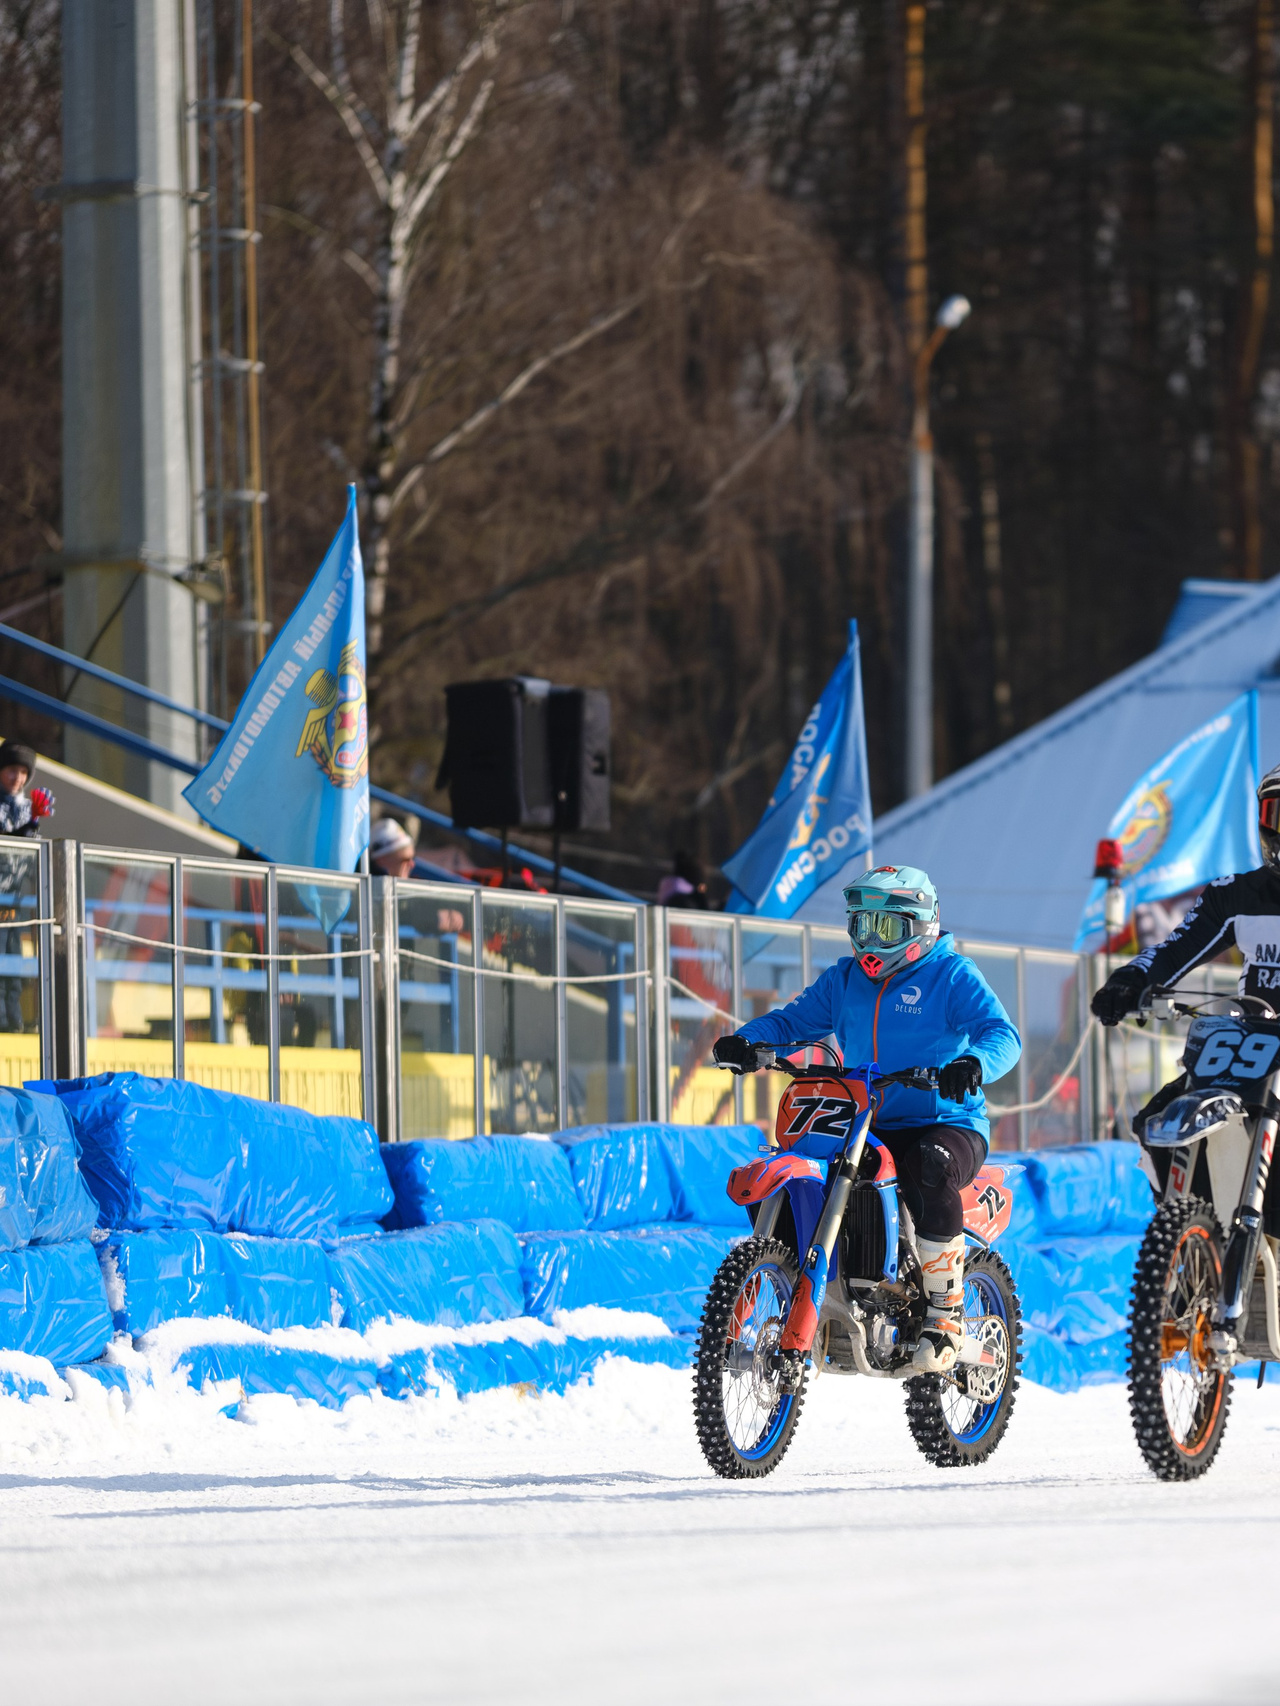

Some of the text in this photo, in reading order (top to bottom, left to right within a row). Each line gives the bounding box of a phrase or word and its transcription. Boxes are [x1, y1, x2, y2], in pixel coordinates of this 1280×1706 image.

[895, 1003, 922, 1015] DELRUS
[783, 1096, 860, 1139] 72
[976, 1184, 1007, 1222] 72
